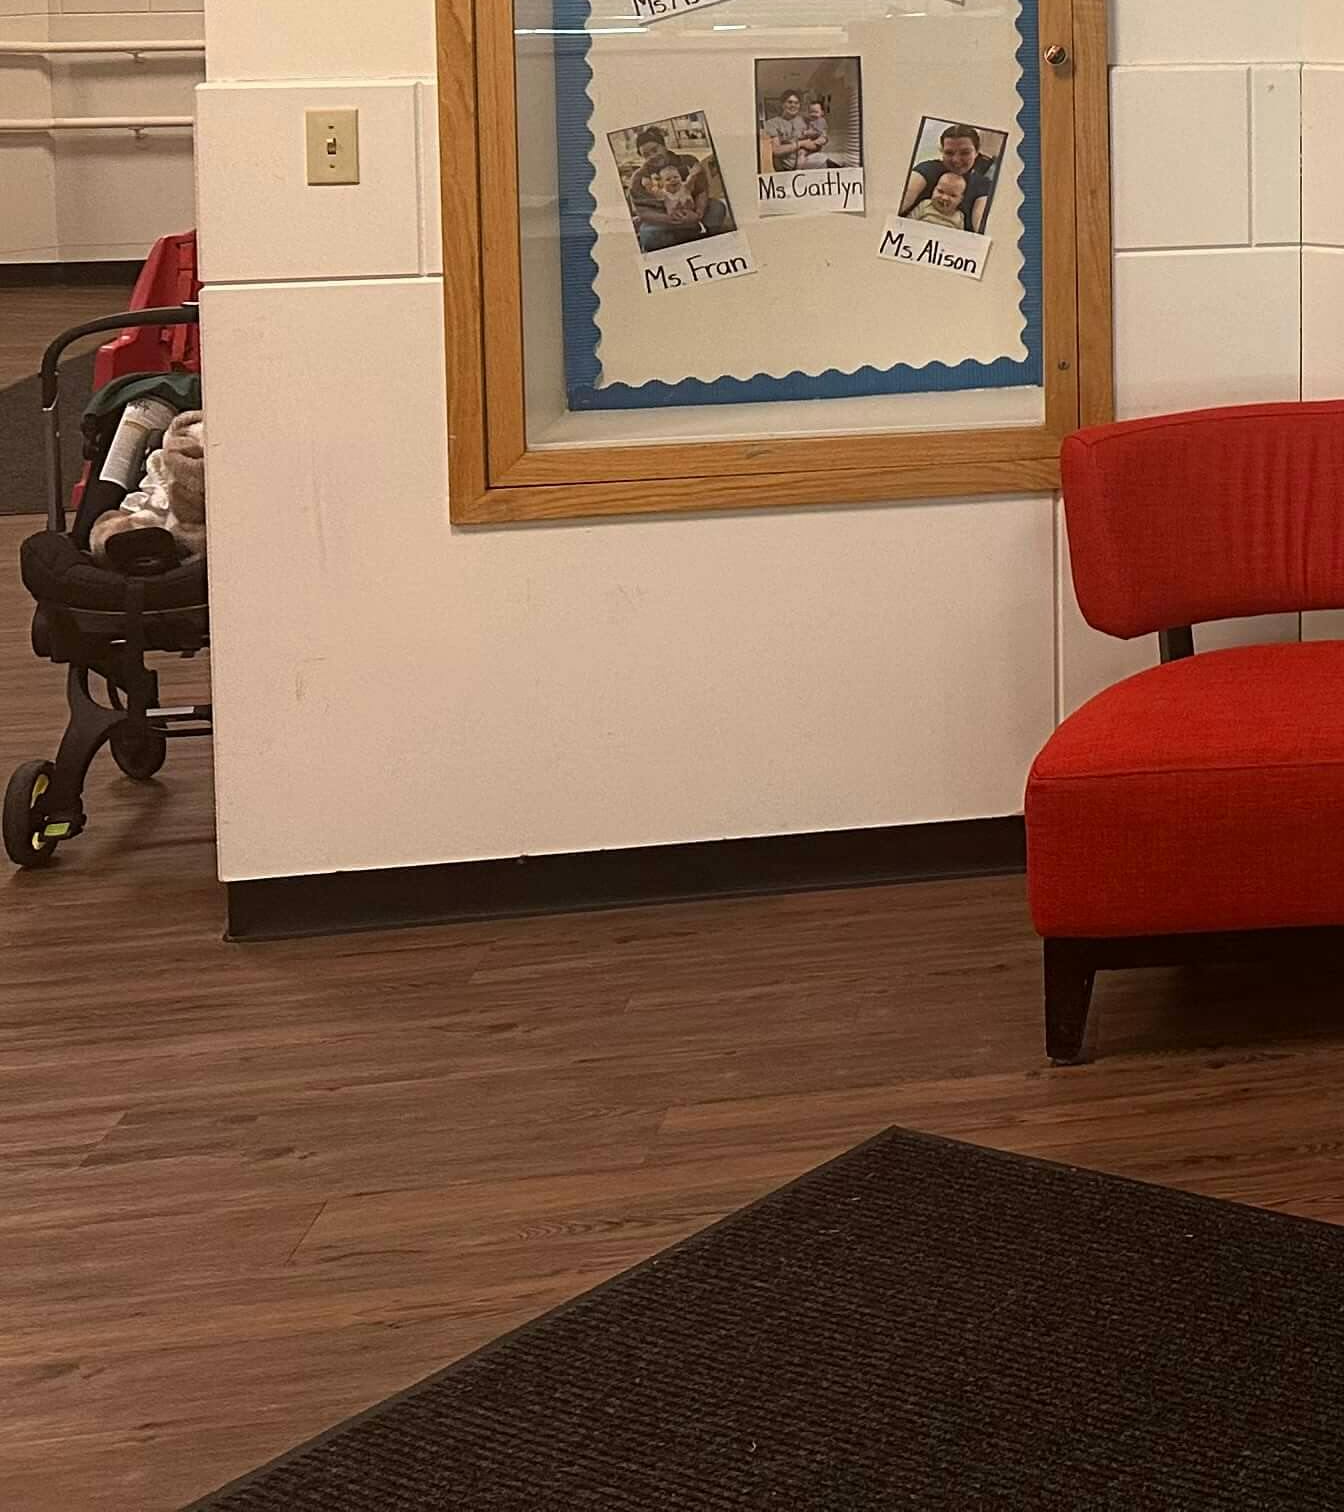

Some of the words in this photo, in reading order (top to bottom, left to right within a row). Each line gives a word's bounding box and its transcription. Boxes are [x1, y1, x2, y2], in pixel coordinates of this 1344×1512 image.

[758, 176, 790, 200] Ms.
[879, 231, 914, 261] Ms.
[916, 239, 977, 274] Alison
[644, 267, 687, 294] Ms.
[688, 254, 748, 285] Fran
